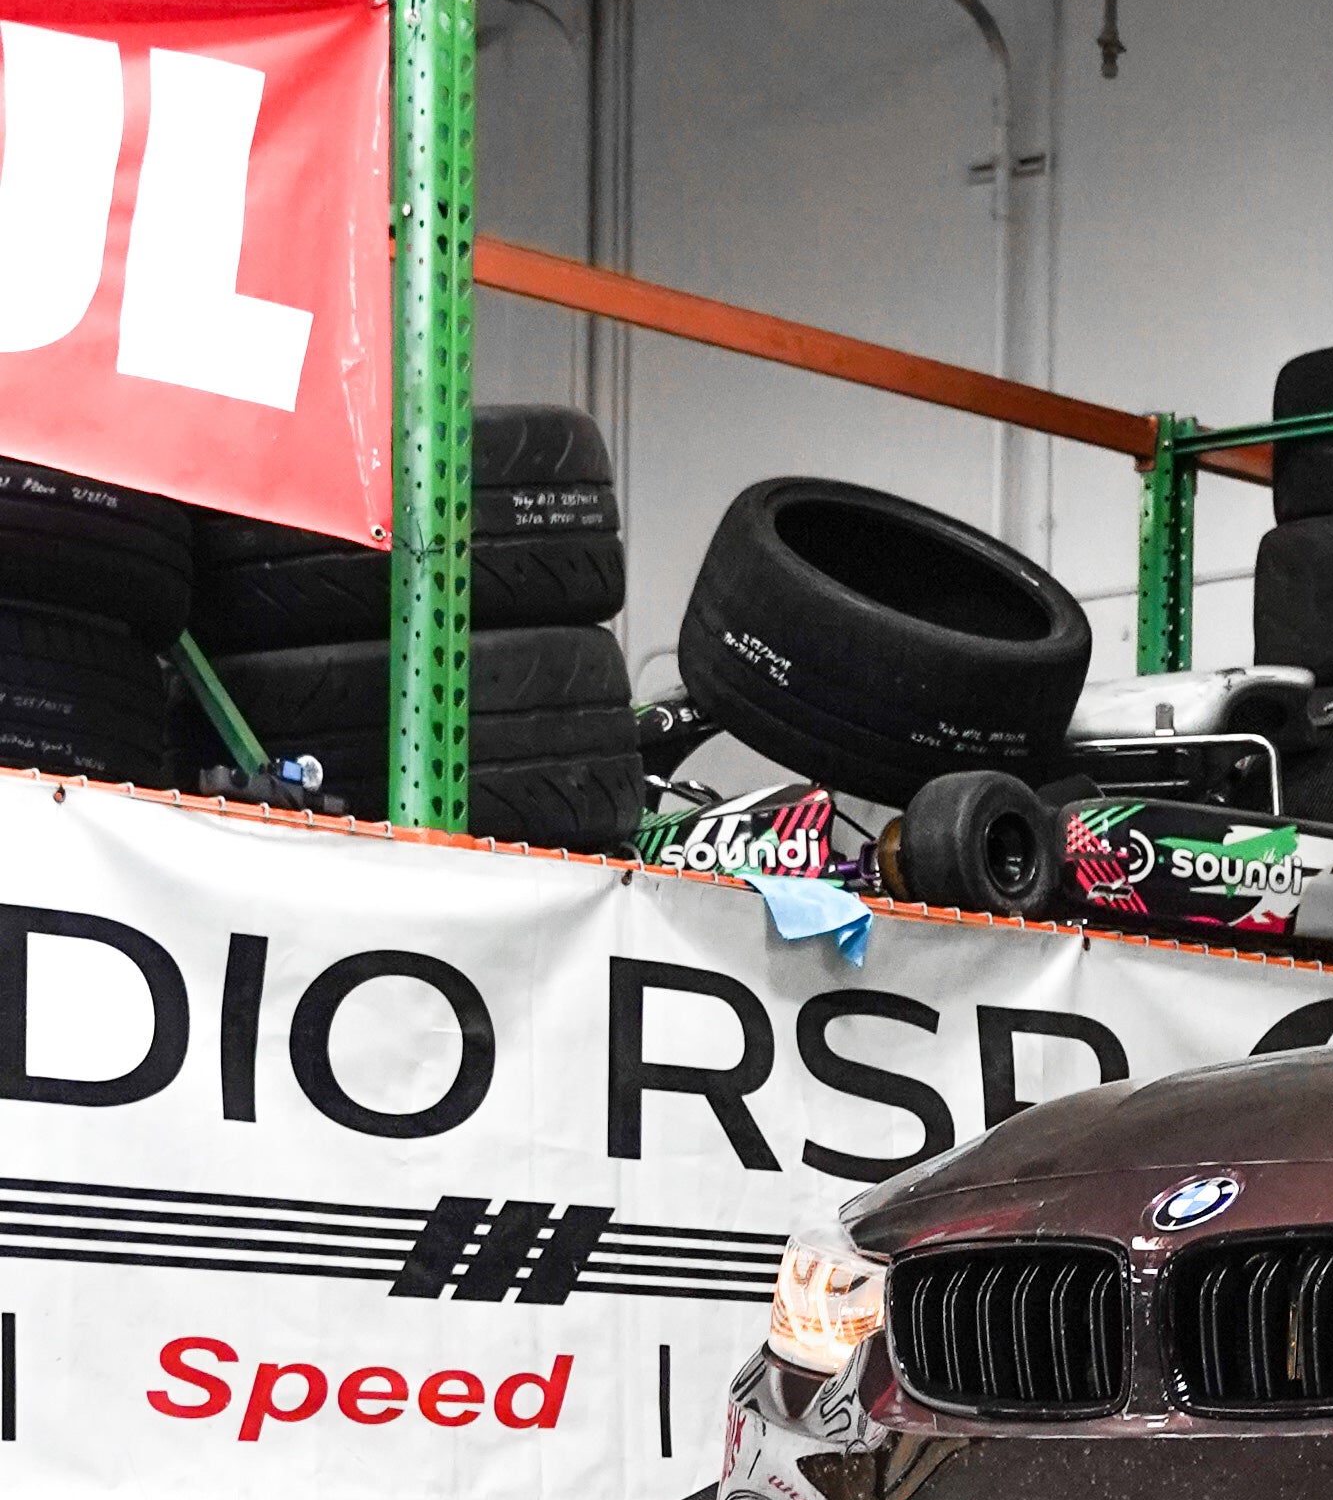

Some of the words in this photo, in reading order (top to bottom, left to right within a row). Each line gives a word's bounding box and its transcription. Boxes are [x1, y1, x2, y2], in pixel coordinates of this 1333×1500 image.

[660, 828, 822, 871] soundi
[1171, 849, 1303, 896] soundi
[0, 904, 496, 1139] DIO
[146, 1336, 575, 1442] Speed
